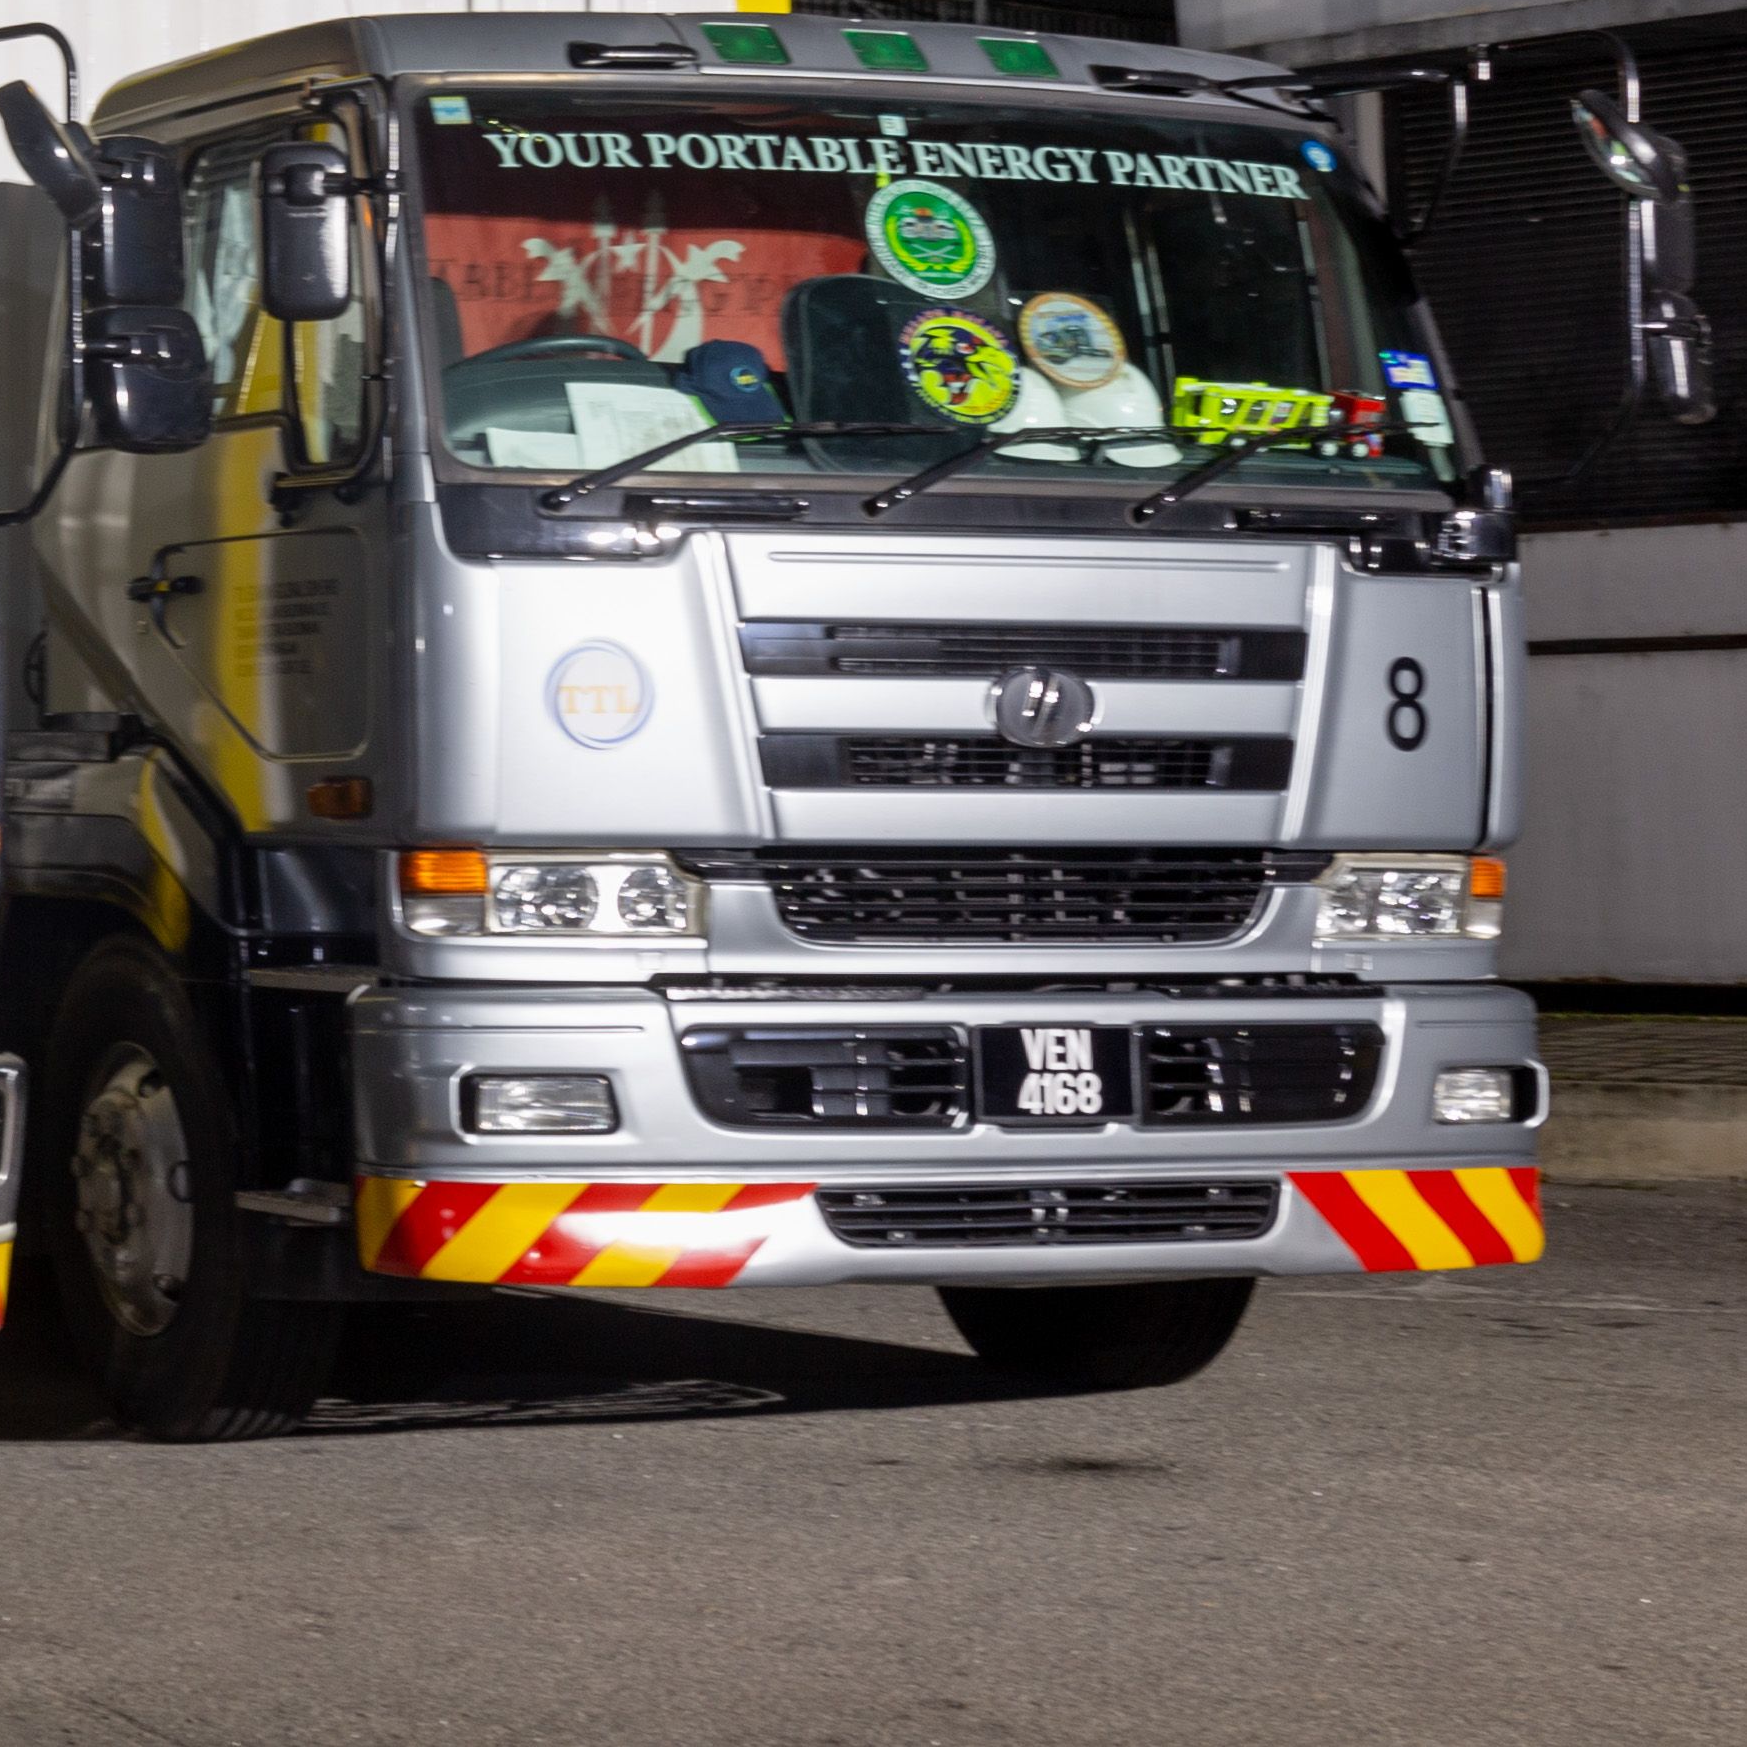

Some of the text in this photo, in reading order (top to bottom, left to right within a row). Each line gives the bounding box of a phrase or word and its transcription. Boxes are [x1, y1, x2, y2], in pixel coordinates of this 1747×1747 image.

[484, 132, 645, 169] YOUR
[649, 133, 906, 175] PORTABLE
[909, 142, 1099, 182] ENERGY
[1104, 150, 1309, 200] PARTNER
[557, 686, 642, 715] TTL
[1386, 657, 1429, 752] 8
[1021, 1028, 1092, 1070] VEN
[1018, 1072, 1103, 1115] 4168
